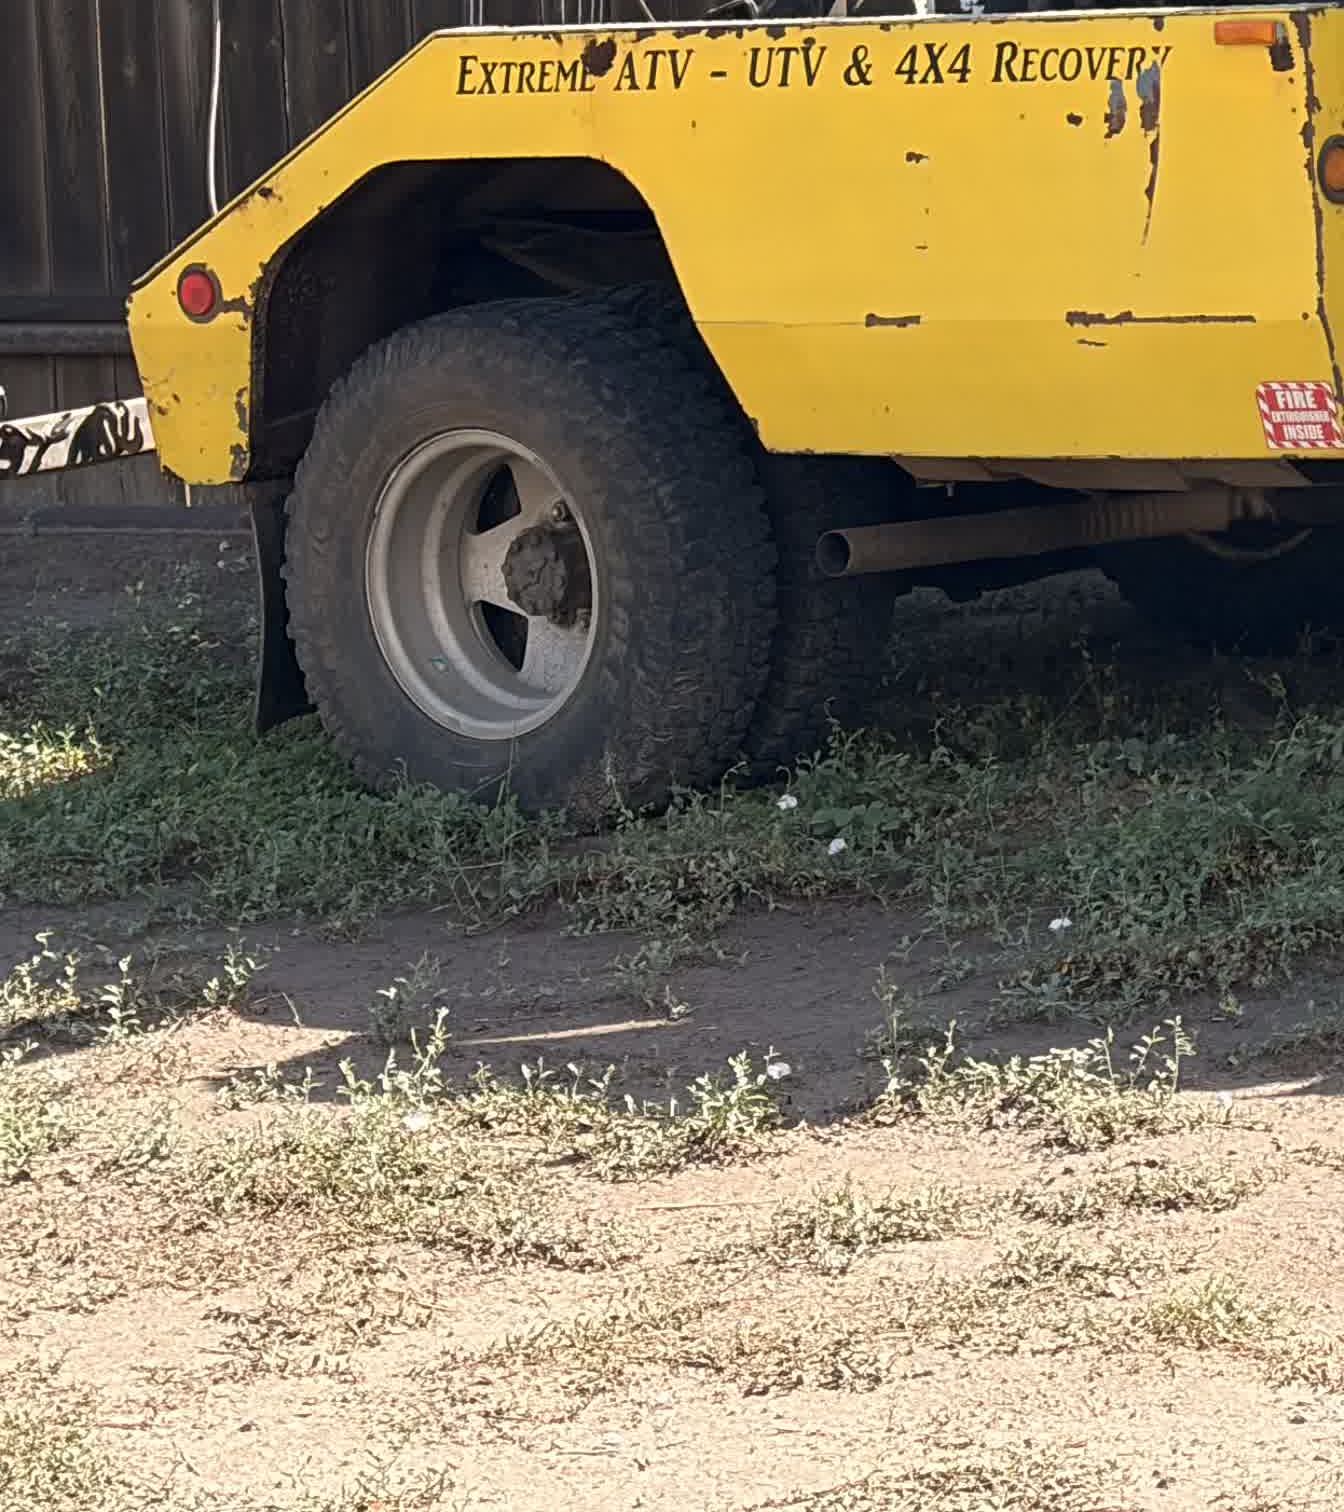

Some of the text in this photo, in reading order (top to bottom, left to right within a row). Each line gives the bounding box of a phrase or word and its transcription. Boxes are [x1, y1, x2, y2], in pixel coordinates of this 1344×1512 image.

[613, 49, 694, 90] ATV
[710, 70, 727, 79] -
[748, 46, 827, 87] UTV
[843, 44, 873, 86] &
[895, 42, 972, 85] 4X4
[1275, 390, 1317, 409] FIRE
[1283, 424, 1324, 440] INSIDE
